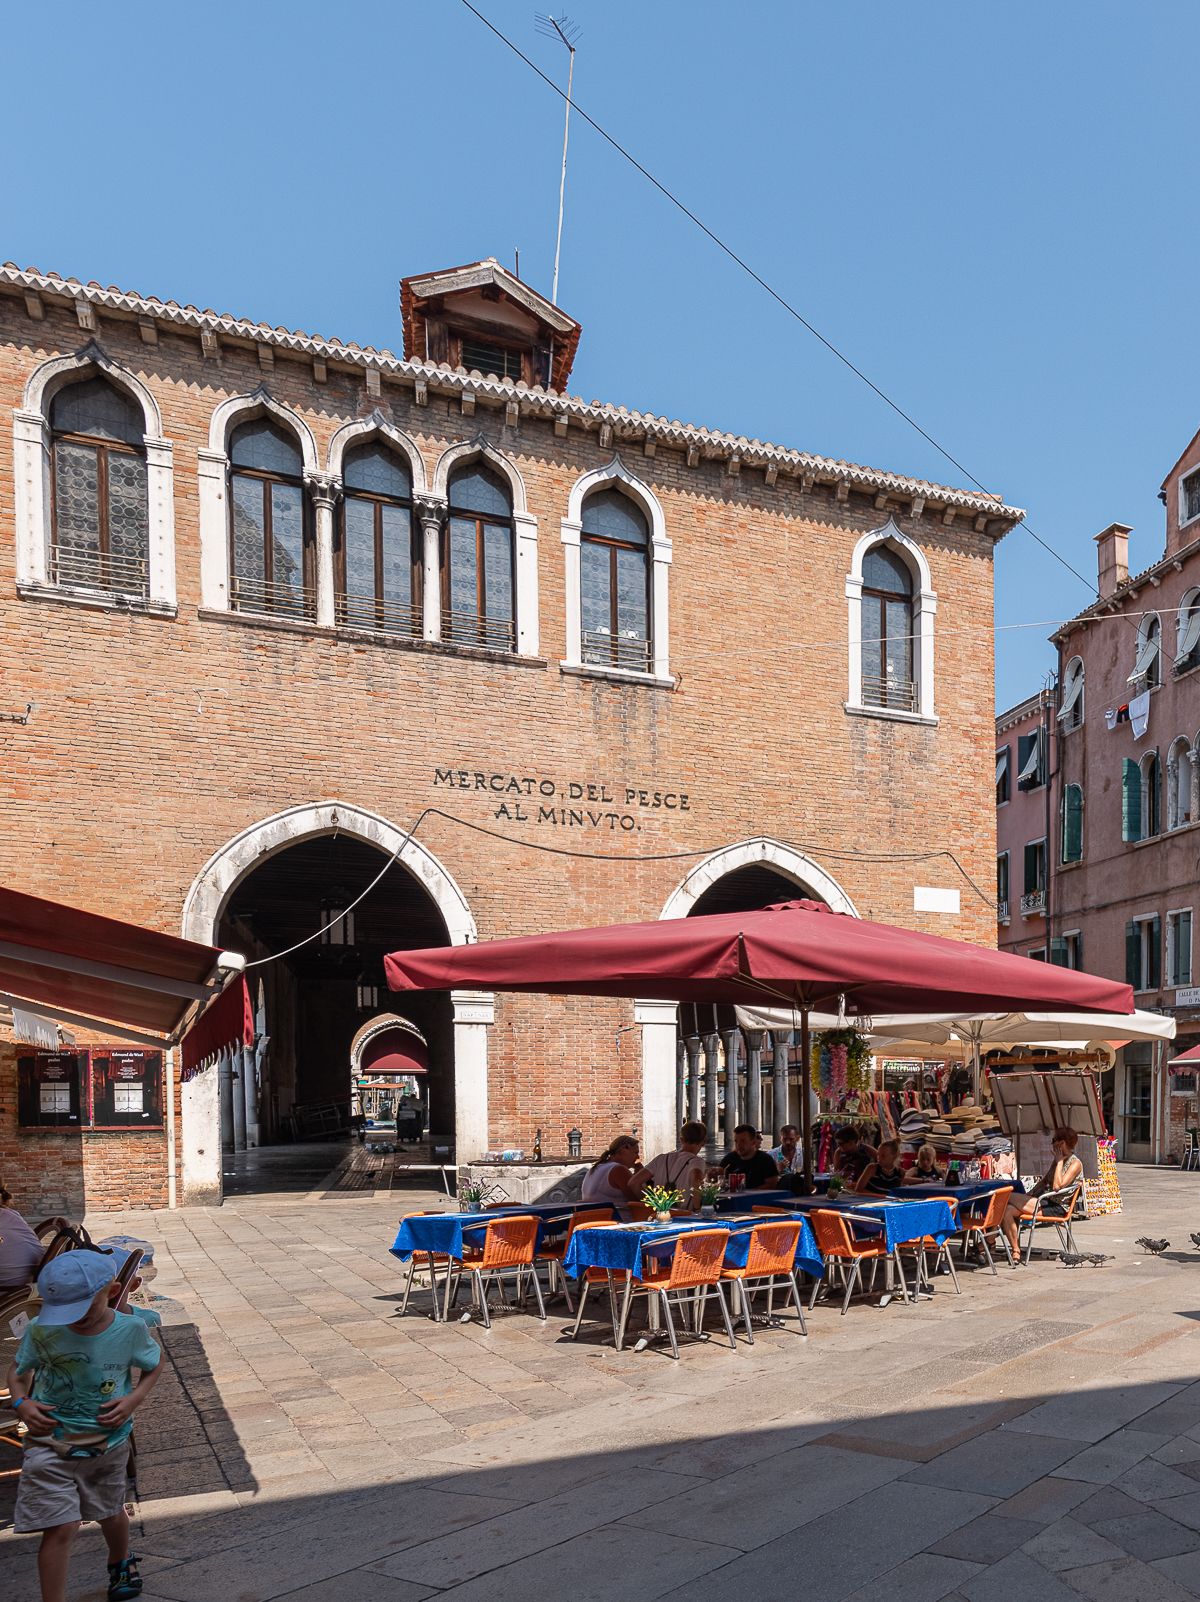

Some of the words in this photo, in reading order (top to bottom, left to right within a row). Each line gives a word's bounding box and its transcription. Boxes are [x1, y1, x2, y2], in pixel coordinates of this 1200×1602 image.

[433, 768, 556, 797] MERCATO
[569, 782, 613, 803] DEL
[625, 788, 691, 811] PESCE
[494, 803, 528, 821] AL
